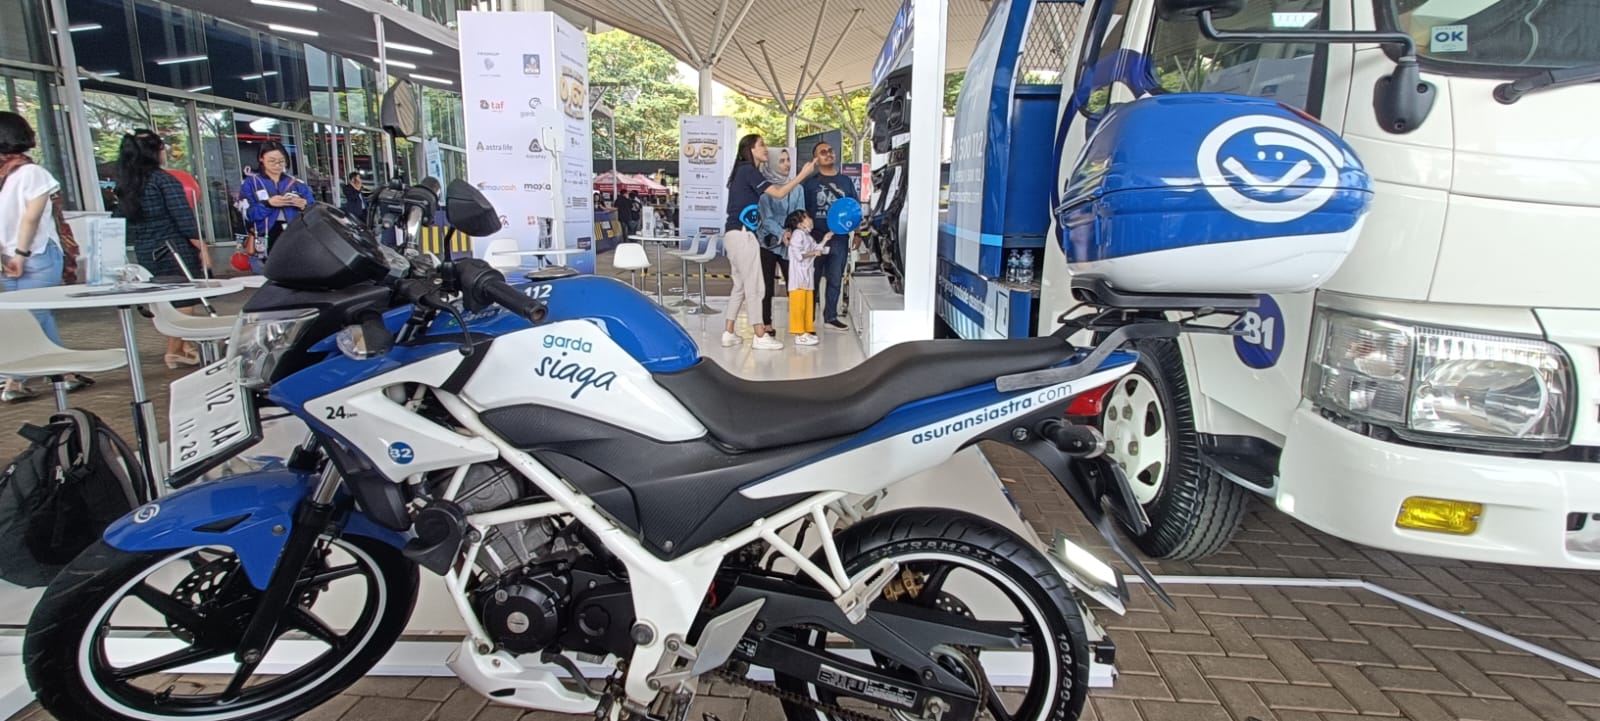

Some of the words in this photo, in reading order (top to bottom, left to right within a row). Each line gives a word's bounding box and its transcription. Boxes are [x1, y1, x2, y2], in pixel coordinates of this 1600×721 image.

[1434, 31, 1464, 43] OK
[491, 101, 504, 109] taf
[503, 143, 513, 151] life
[524, 284, 553, 299] 112
[542, 334, 593, 353] garda
[534, 351, 617, 399] siaga
[205, 382, 235, 412] 112
[325, 405, 346, 420] 24
[912, 384, 1073, 445] asuransiastra.com
[209, 421, 242, 448] AA
[1053, 633, 1073, 721] 100/80-1
